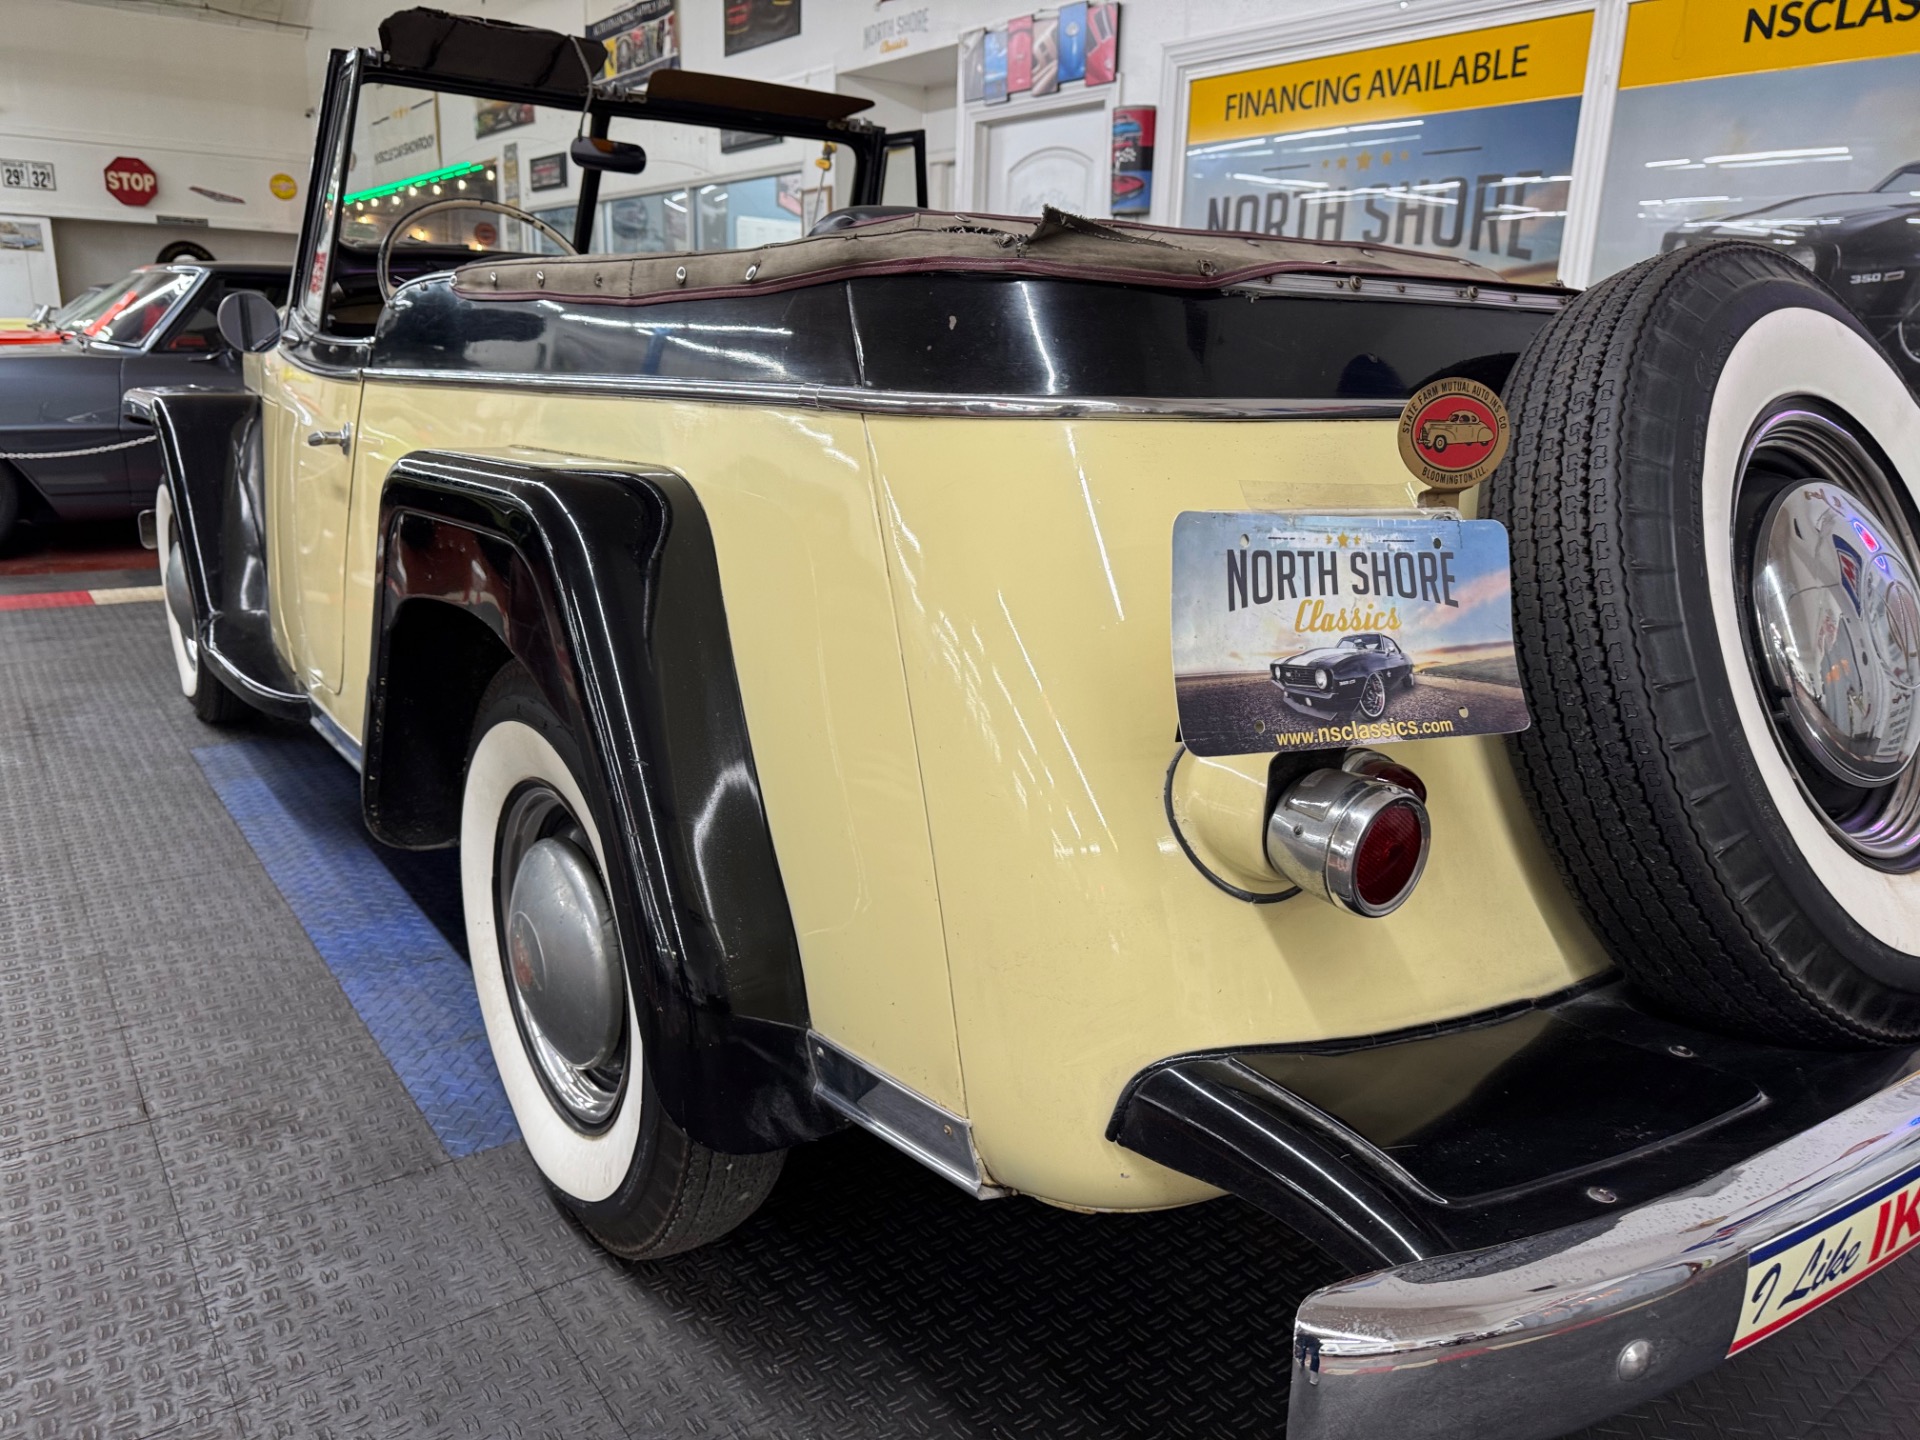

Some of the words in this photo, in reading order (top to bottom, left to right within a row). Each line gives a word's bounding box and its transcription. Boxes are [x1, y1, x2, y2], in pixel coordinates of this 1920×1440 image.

[1225, 73, 1361, 122] FINANCING
[1367, 44, 1531, 100] AVAILABLE
[106, 170, 155, 193] STOP
[1362, 170, 1543, 261] SHORE
[1849, 272, 1882, 285] 350
[1402, 403, 1419, 434] STATE
[1417, 385, 1439, 405] FARM
[1441, 381, 1470, 393] MUTUAL
[1471, 385, 1490, 401] AUTO
[1226, 548, 1339, 612] NORTH
[1350, 550, 1459, 608] SHORE
[1294, 598, 1402, 633] Classics
[1276, 717, 1455, 747] www.nsclassics.com
[1751, 1262, 1782, 1324] I
[1777, 1226, 1862, 1311] Like
